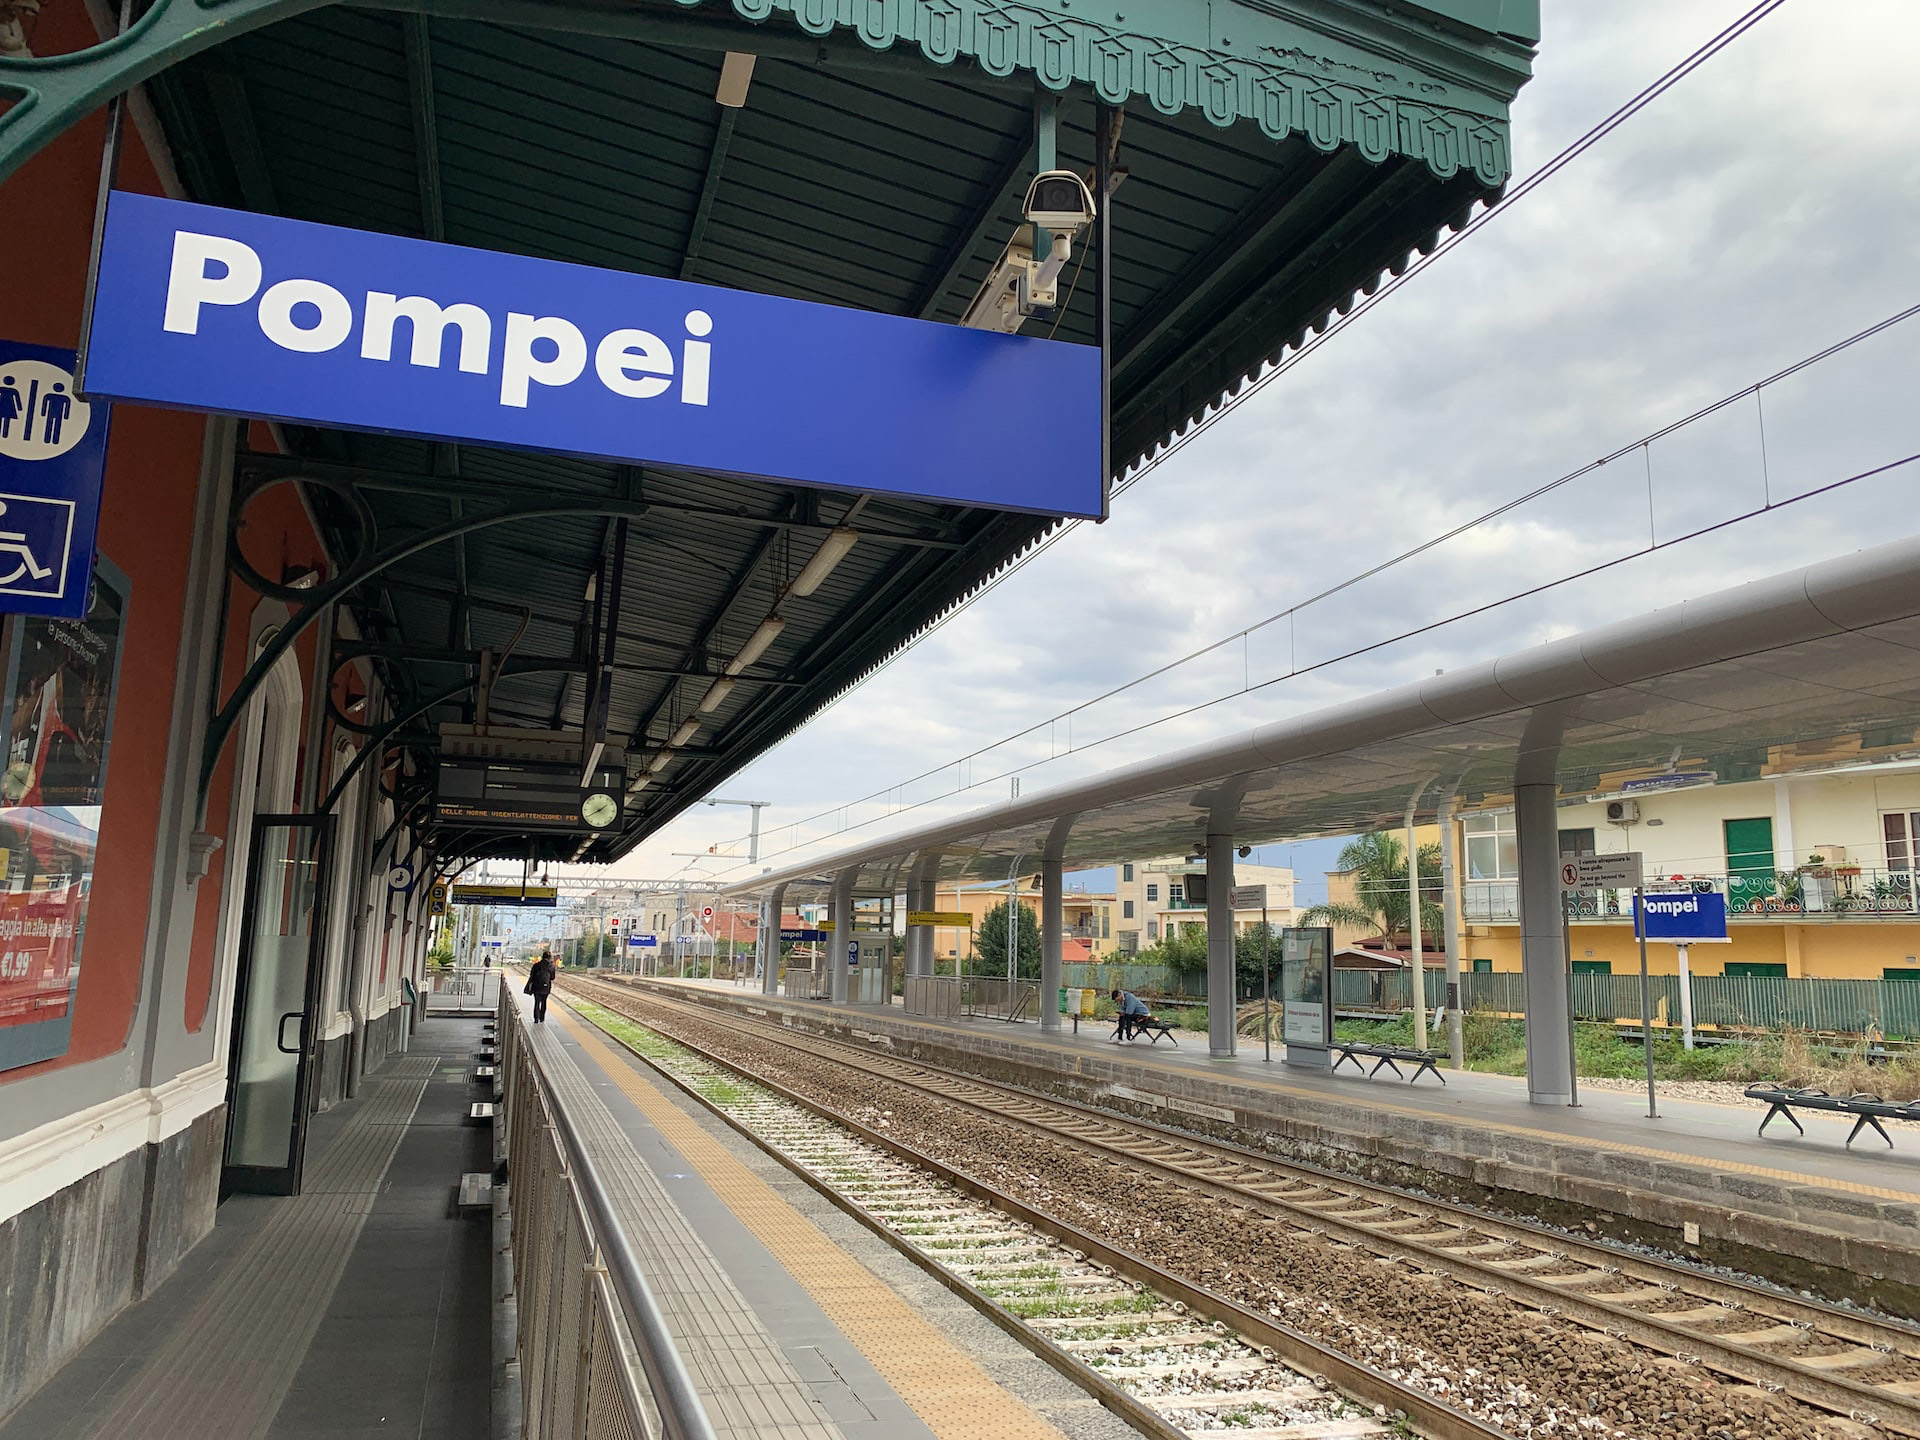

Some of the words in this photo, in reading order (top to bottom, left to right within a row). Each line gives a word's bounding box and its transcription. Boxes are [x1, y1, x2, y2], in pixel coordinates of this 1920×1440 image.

[163, 230, 713, 408] Pompei
[441, 808, 463, 816] DELLE
[1601, 873, 1618, 881] beyond
